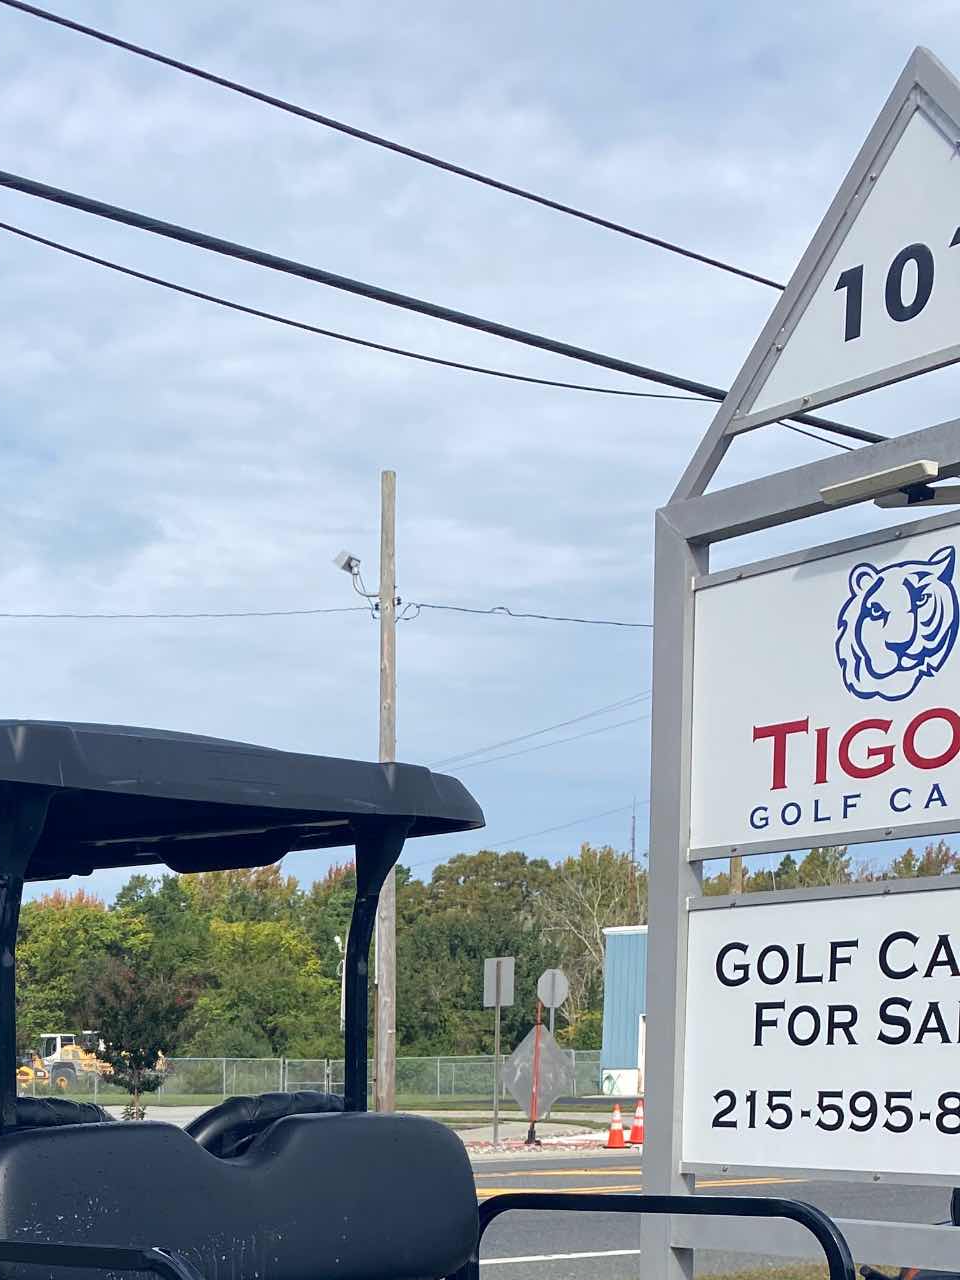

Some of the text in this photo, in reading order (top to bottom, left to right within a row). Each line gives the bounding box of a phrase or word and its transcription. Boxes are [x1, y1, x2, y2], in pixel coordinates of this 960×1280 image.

[752, 707, 960, 791] TIGO
[749, 783, 947, 829] GOLF CA
[715, 931, 960, 987] GOLF CA
[753, 996, 960, 1046] FOR SA
[711, 1089, 960, 1135] 215-595-8
